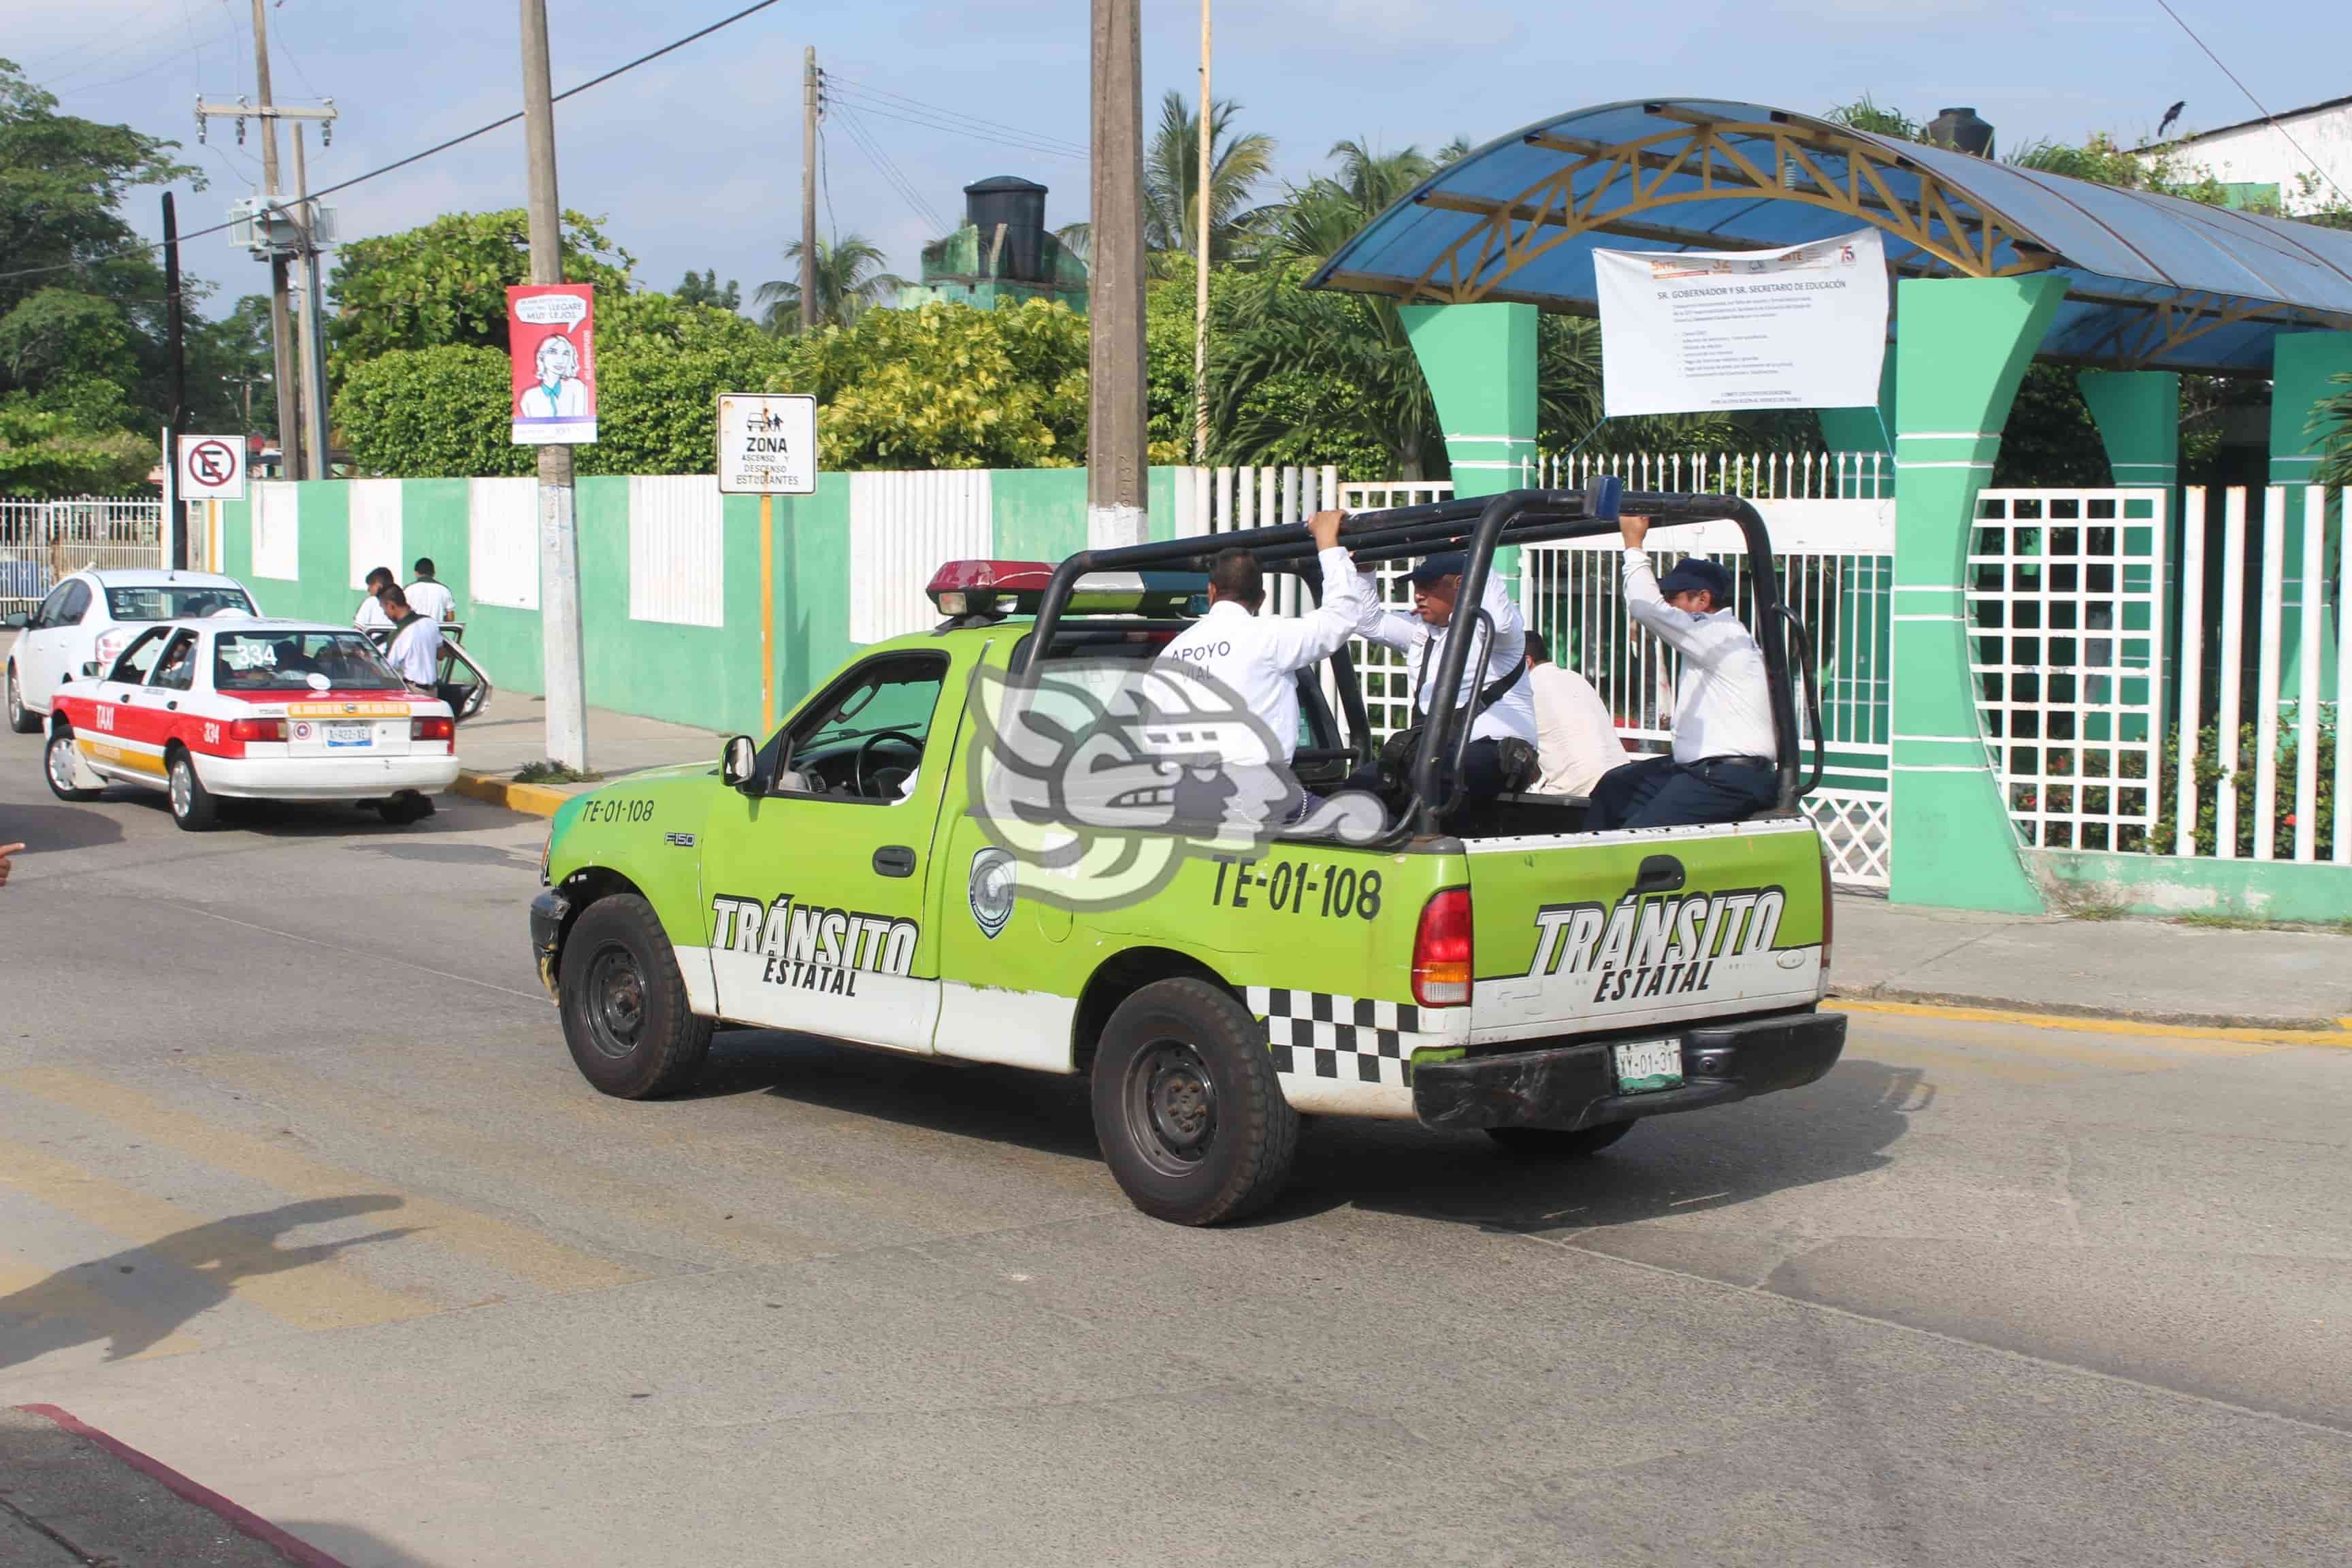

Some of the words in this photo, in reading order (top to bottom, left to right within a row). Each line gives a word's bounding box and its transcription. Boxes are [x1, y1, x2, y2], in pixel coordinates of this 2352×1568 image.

[1657, 291, 1669, 299] SR.
[1671, 287, 1728, 299] GOBERNADOR
[1736, 286, 1747, 294] SR.
[1748, 283, 1792, 293] SECRETARIO
[1795, 282, 1805, 291] DE
[1806, 278, 1846, 289] EDUCACIÓN
[747, 437, 788, 453] ZONA
[742, 454, 775, 463] ASCENSO
[744, 464, 787, 473] DESCENSO
[736, 475, 800, 485] ESTUDIANTES
[238, 644, 278, 666] 334
[1171, 641, 1231, 664] APOYO
[1180, 664, 1214, 683] VIAL
[96, 704, 115, 731] TAXI
[204, 722, 220, 745] 334
[583, 800, 654, 823] TE-01-108
[1212, 854, 1382, 920] TE-01-108
[712, 893, 919, 977] TRÁNSITO
[1529, 885, 1786, 976] TRÁNSITO
[762, 957, 857, 998] ESTATAL
[1594, 960, 1714, 1003] ESTATAL
